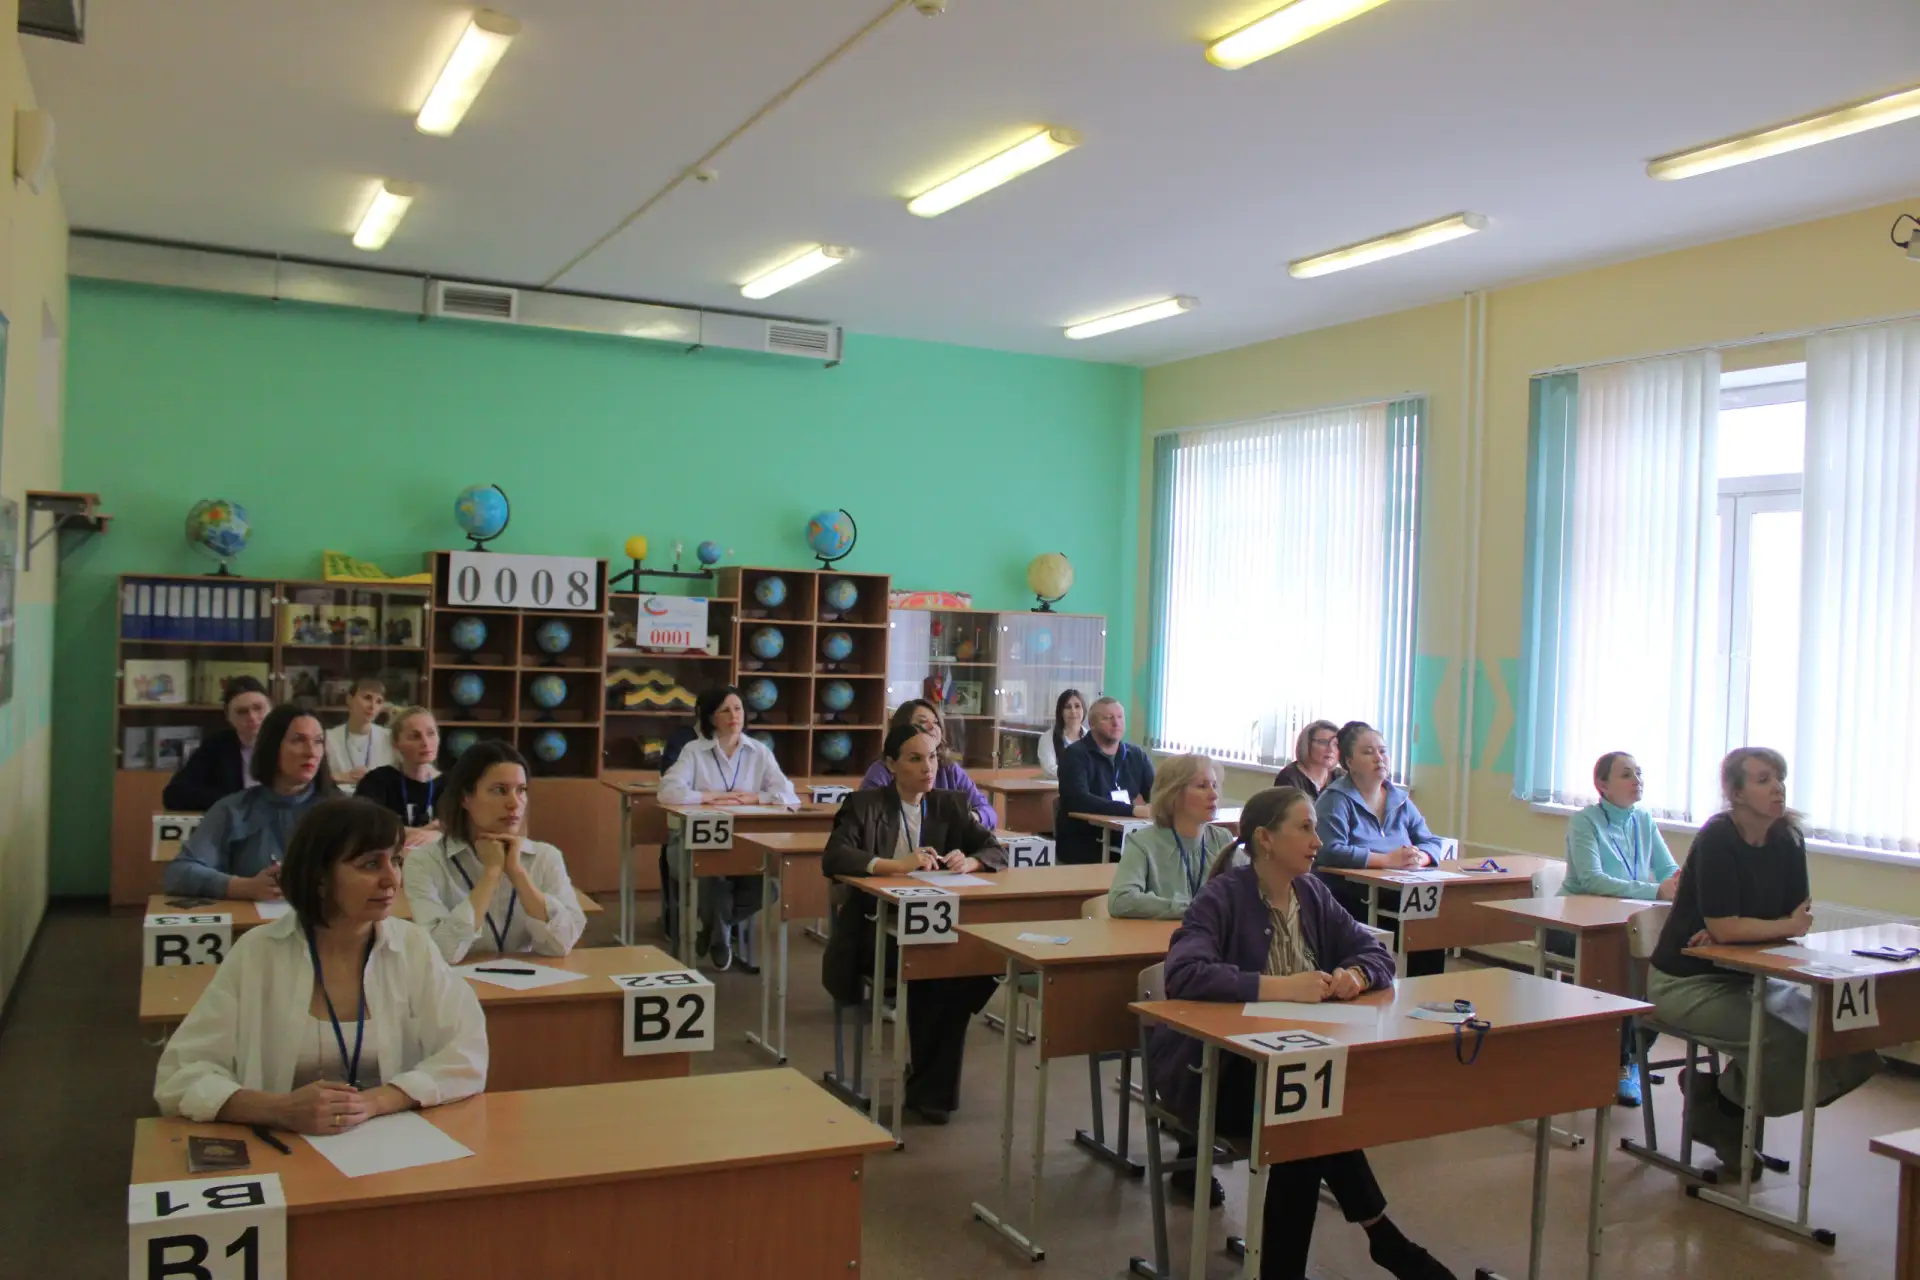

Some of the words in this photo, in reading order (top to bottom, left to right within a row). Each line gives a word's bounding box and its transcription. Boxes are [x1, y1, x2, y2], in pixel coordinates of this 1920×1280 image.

[692, 820, 729, 844] Б5
[904, 901, 953, 935] Б3
[1402, 886, 1438, 913] А3
[634, 993, 705, 1043] В2
[1836, 978, 1869, 1020] А1
[1274, 1059, 1333, 1115] Б1
